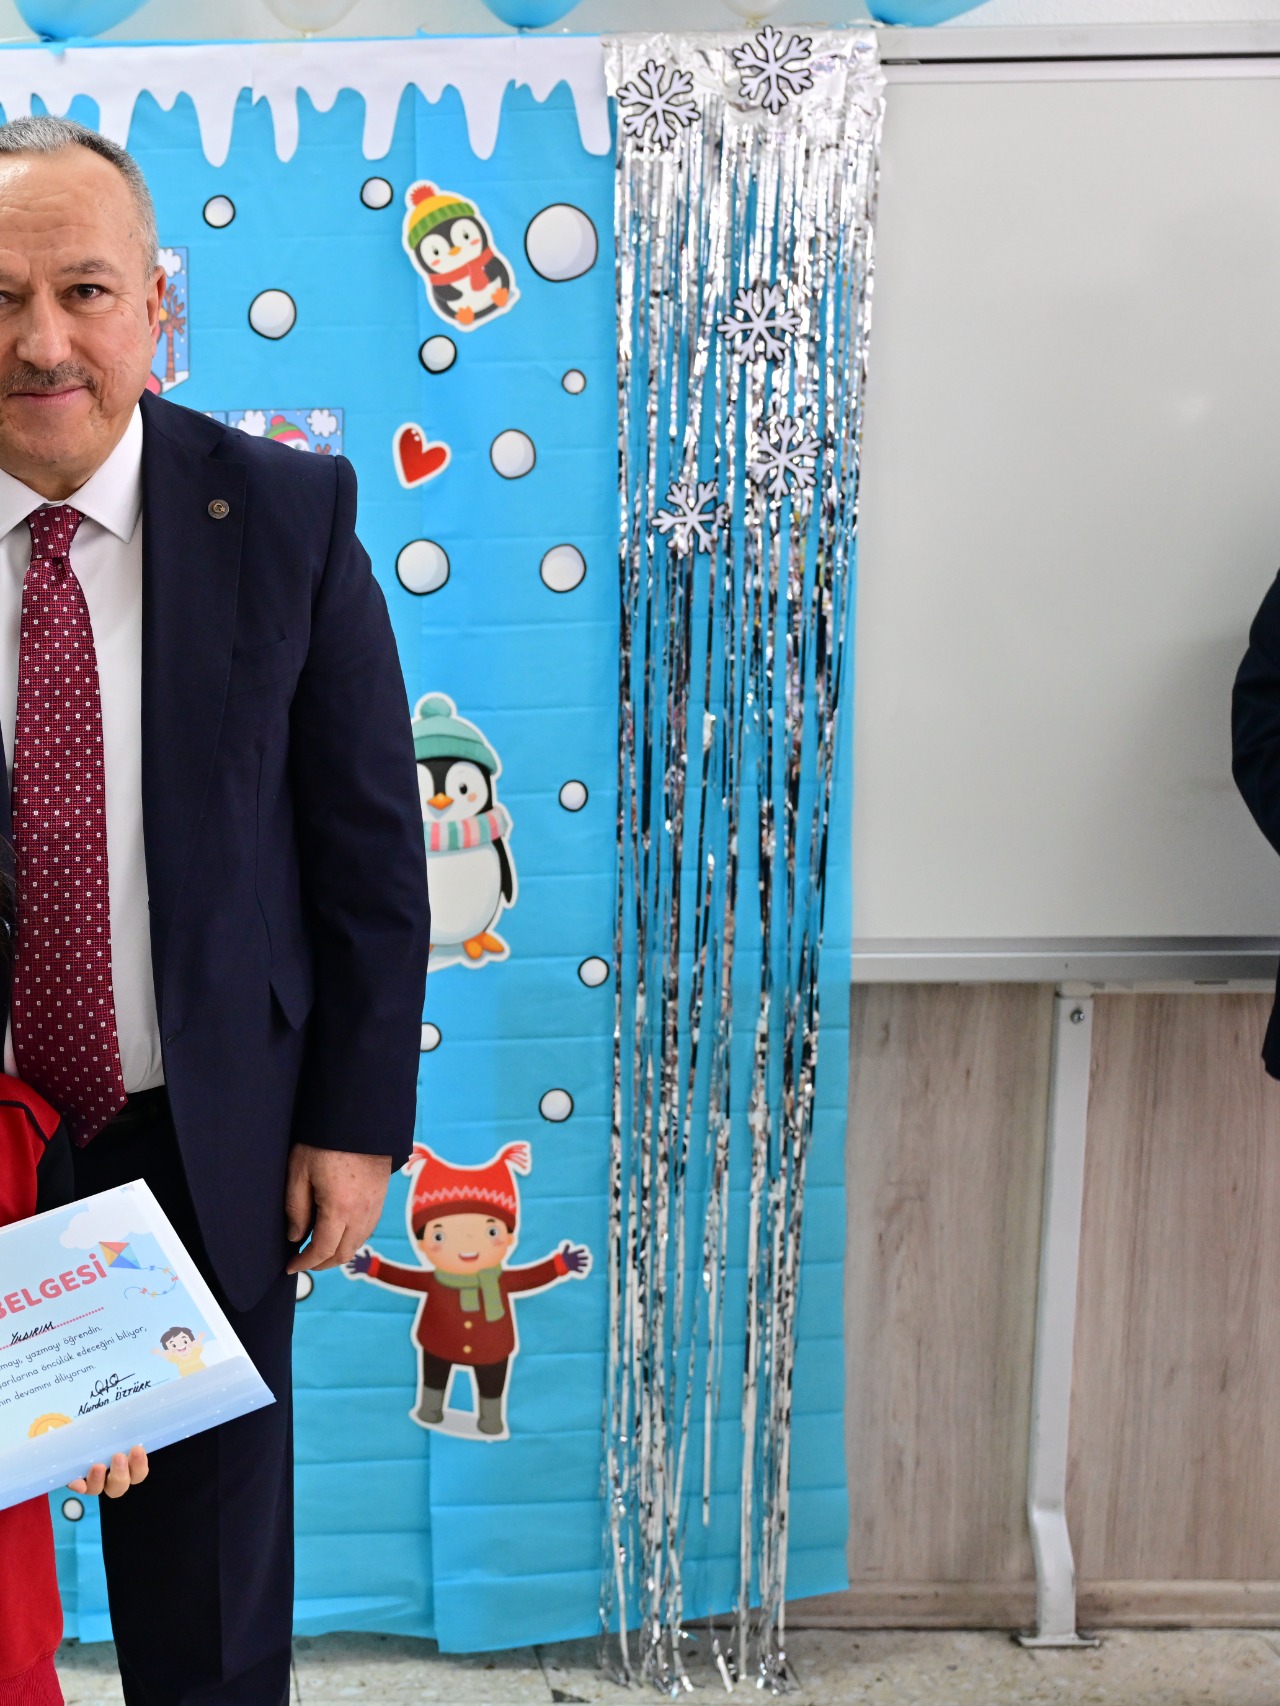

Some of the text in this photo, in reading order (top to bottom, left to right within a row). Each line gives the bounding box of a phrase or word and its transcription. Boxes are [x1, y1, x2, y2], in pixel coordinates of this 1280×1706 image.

[25, 1342, 60, 1363] yazmayı
[63, 1325, 103, 1345] öğrendin.
[41, 1353, 74, 1372] öncülük
[76, 1337, 115, 1358] edeceğini
[116, 1325, 148, 1342] biliyor,
[14, 1382, 52, 1400] devamını
[54, 1364, 97, 1384] diliyorum.
